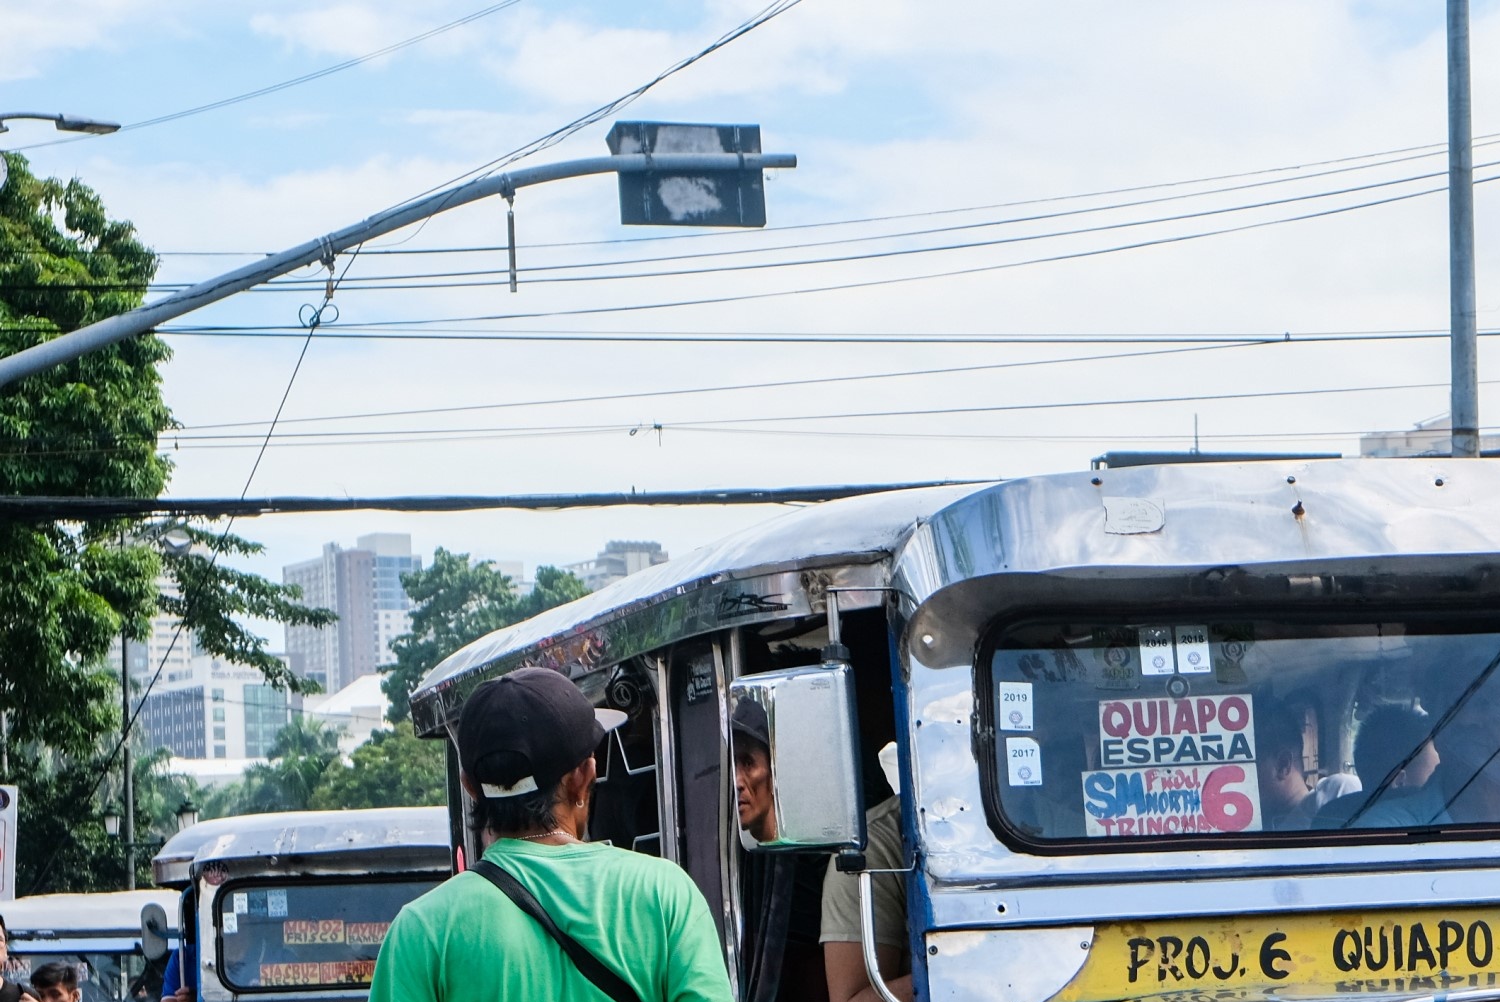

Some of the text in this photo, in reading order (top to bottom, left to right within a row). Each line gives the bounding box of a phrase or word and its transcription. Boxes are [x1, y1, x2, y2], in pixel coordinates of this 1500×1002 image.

[1004, 693, 1027, 702] 2019
[1102, 696, 1249, 739] QUIAPO
[1012, 748, 1035, 758] 2017
[1103, 733, 1253, 765] ESPAÑA
[1085, 771, 1146, 819] SM
[1202, 765, 1253, 831] 6
[286, 932, 338, 943] FRISCO
[1259, 932, 1292, 980] 6
[1332, 922, 1493, 973] QUIAPO
